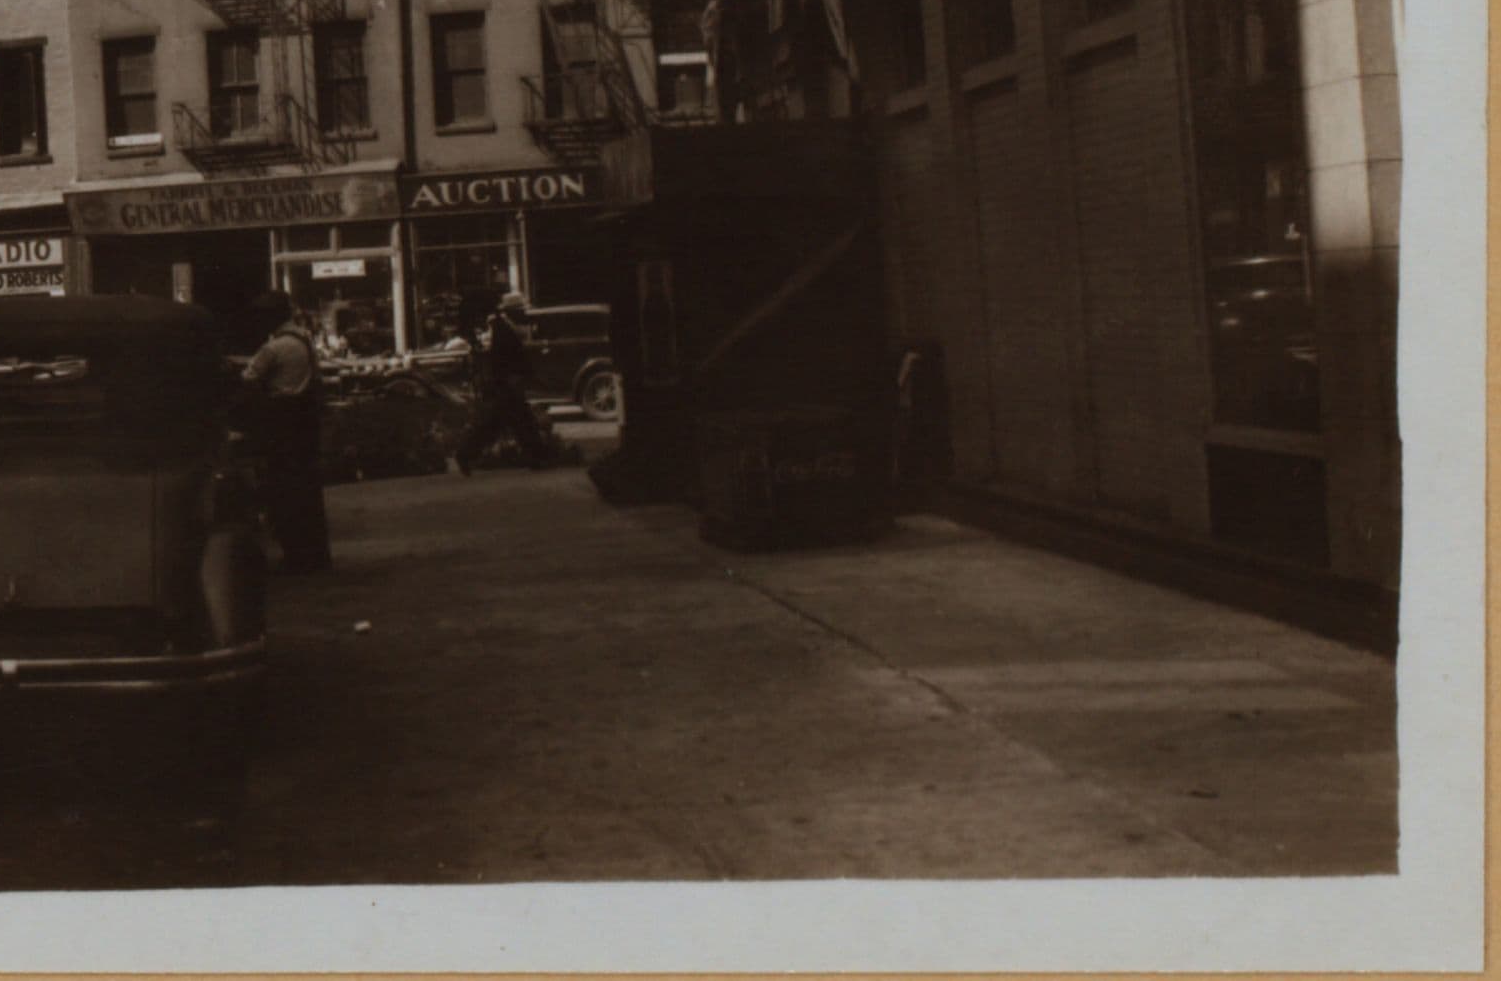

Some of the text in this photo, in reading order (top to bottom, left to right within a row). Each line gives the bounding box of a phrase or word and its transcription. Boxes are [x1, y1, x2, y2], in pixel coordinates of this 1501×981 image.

[409, 173, 585, 208] AUCTION
[121, 192, 343, 228] GENERAL MERCHANDISE
